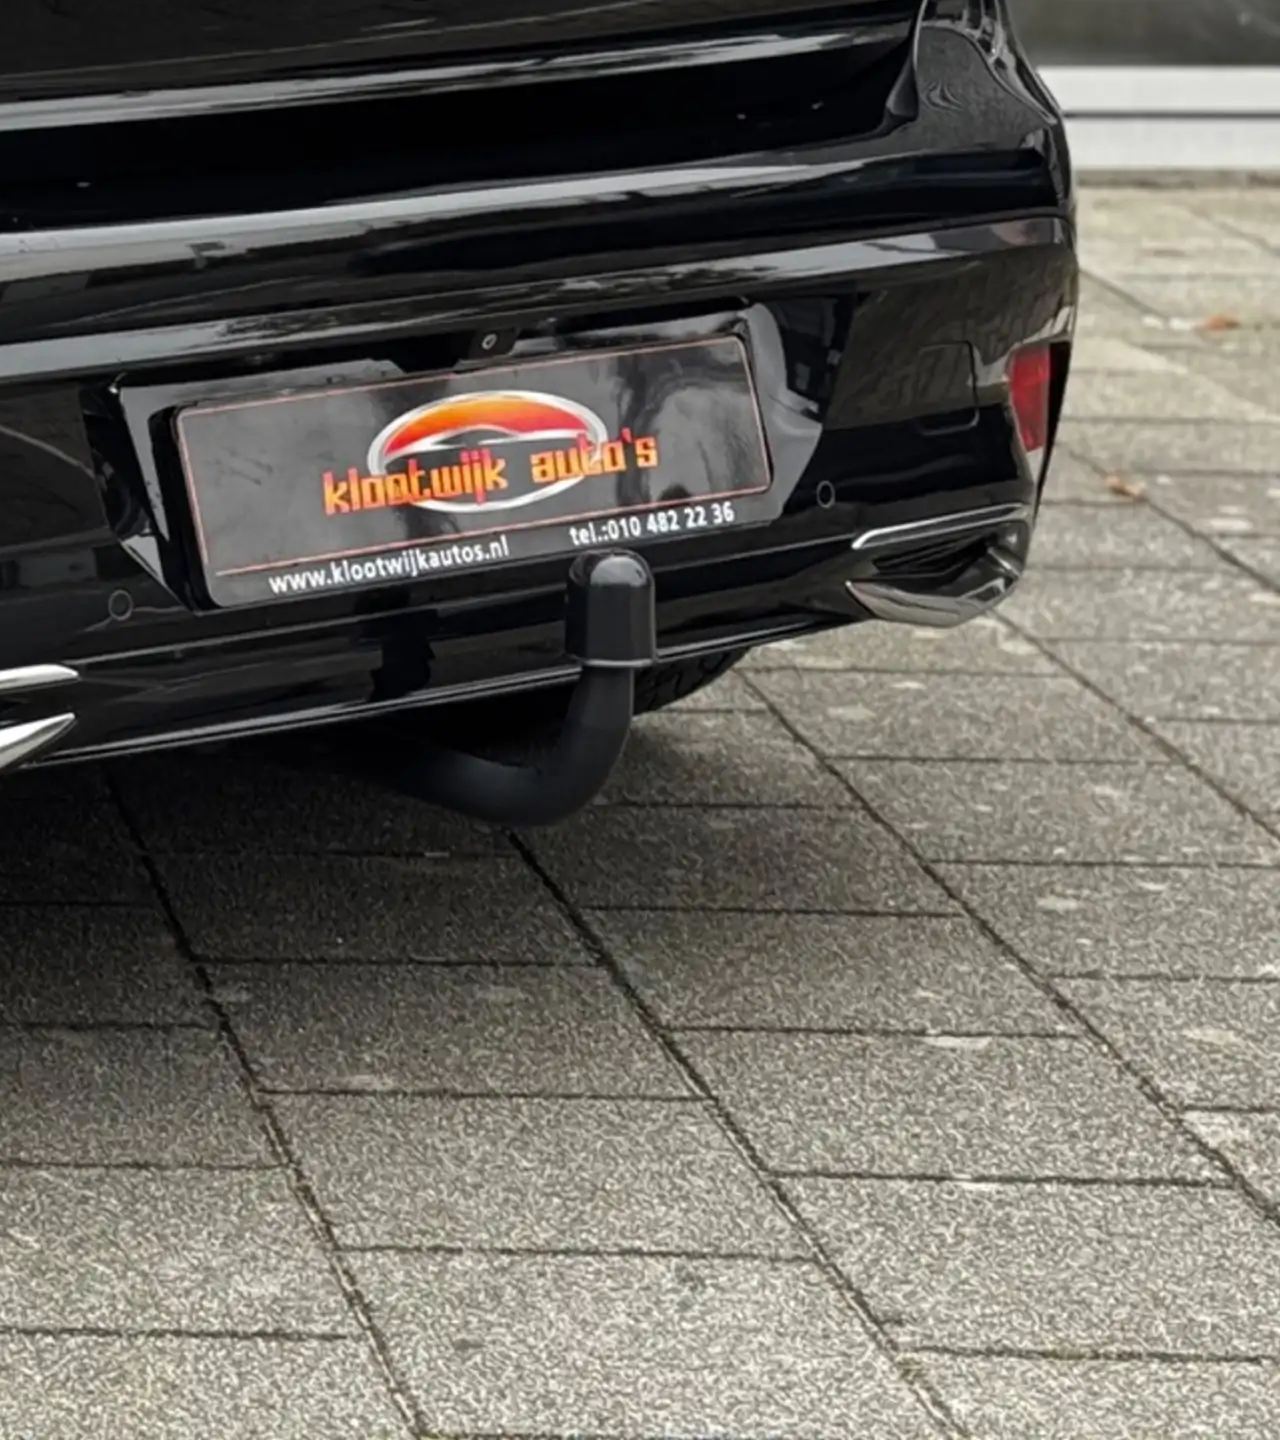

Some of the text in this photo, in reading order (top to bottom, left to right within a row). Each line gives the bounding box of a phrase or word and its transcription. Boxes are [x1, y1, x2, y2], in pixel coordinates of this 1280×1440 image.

[323, 428, 658, 514] klootwijk auto's
[569, 501, 734, 546] tel.:010 482 22 36
[268, 534, 510, 594] www.klootwijkautos.nl
